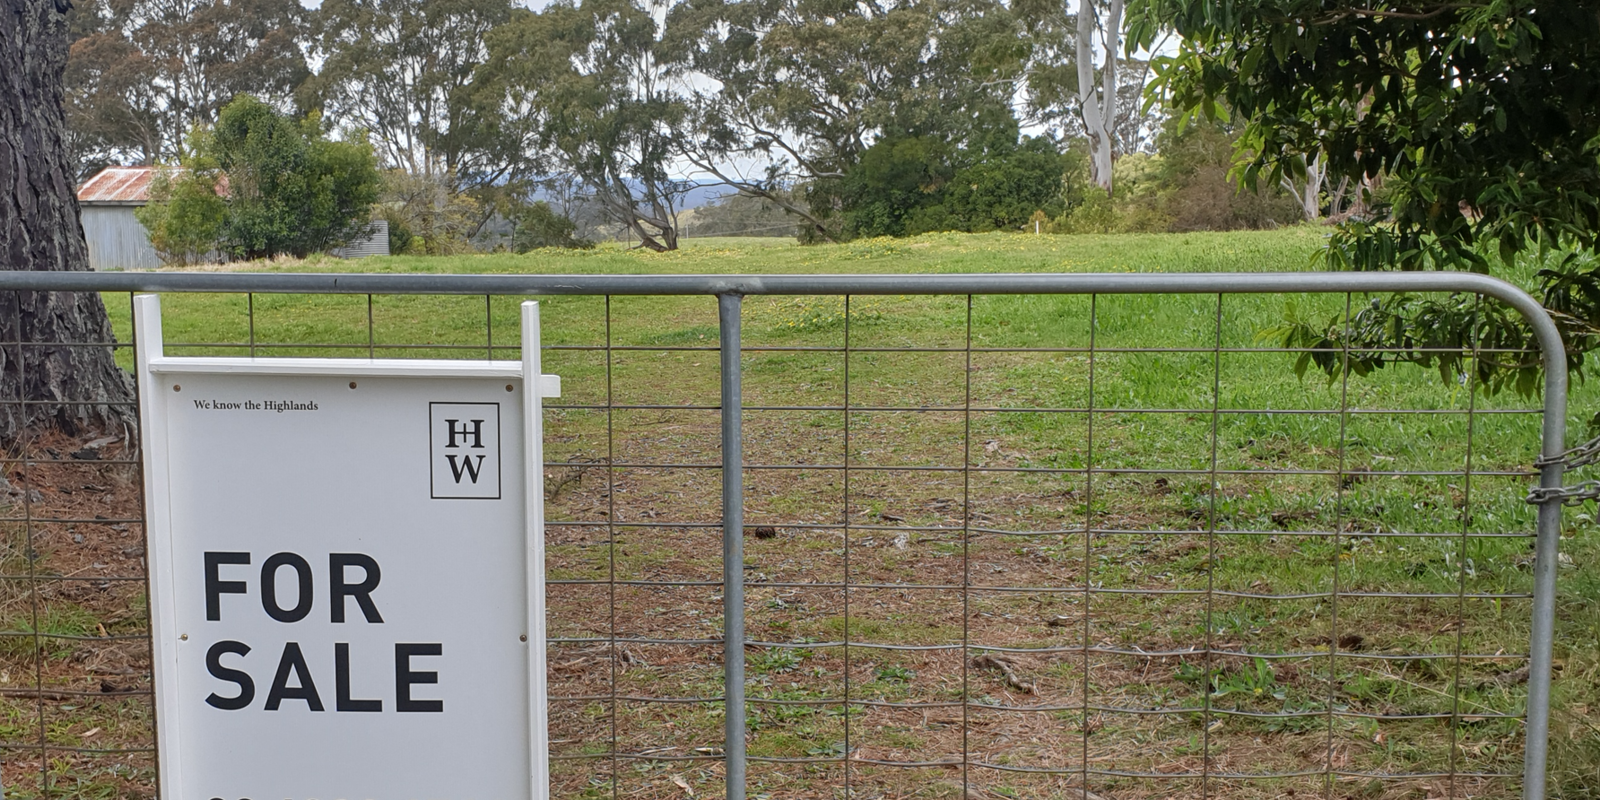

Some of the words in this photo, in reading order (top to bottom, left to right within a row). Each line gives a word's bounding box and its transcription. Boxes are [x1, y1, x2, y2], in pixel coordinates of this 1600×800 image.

[193, 399, 211, 411] We
[212, 399, 242, 411] know
[244, 400, 262, 411] the
[263, 400, 319, 414] Highlands
[203, 551, 385, 624] FOR
[204, 640, 444, 713] SALE
